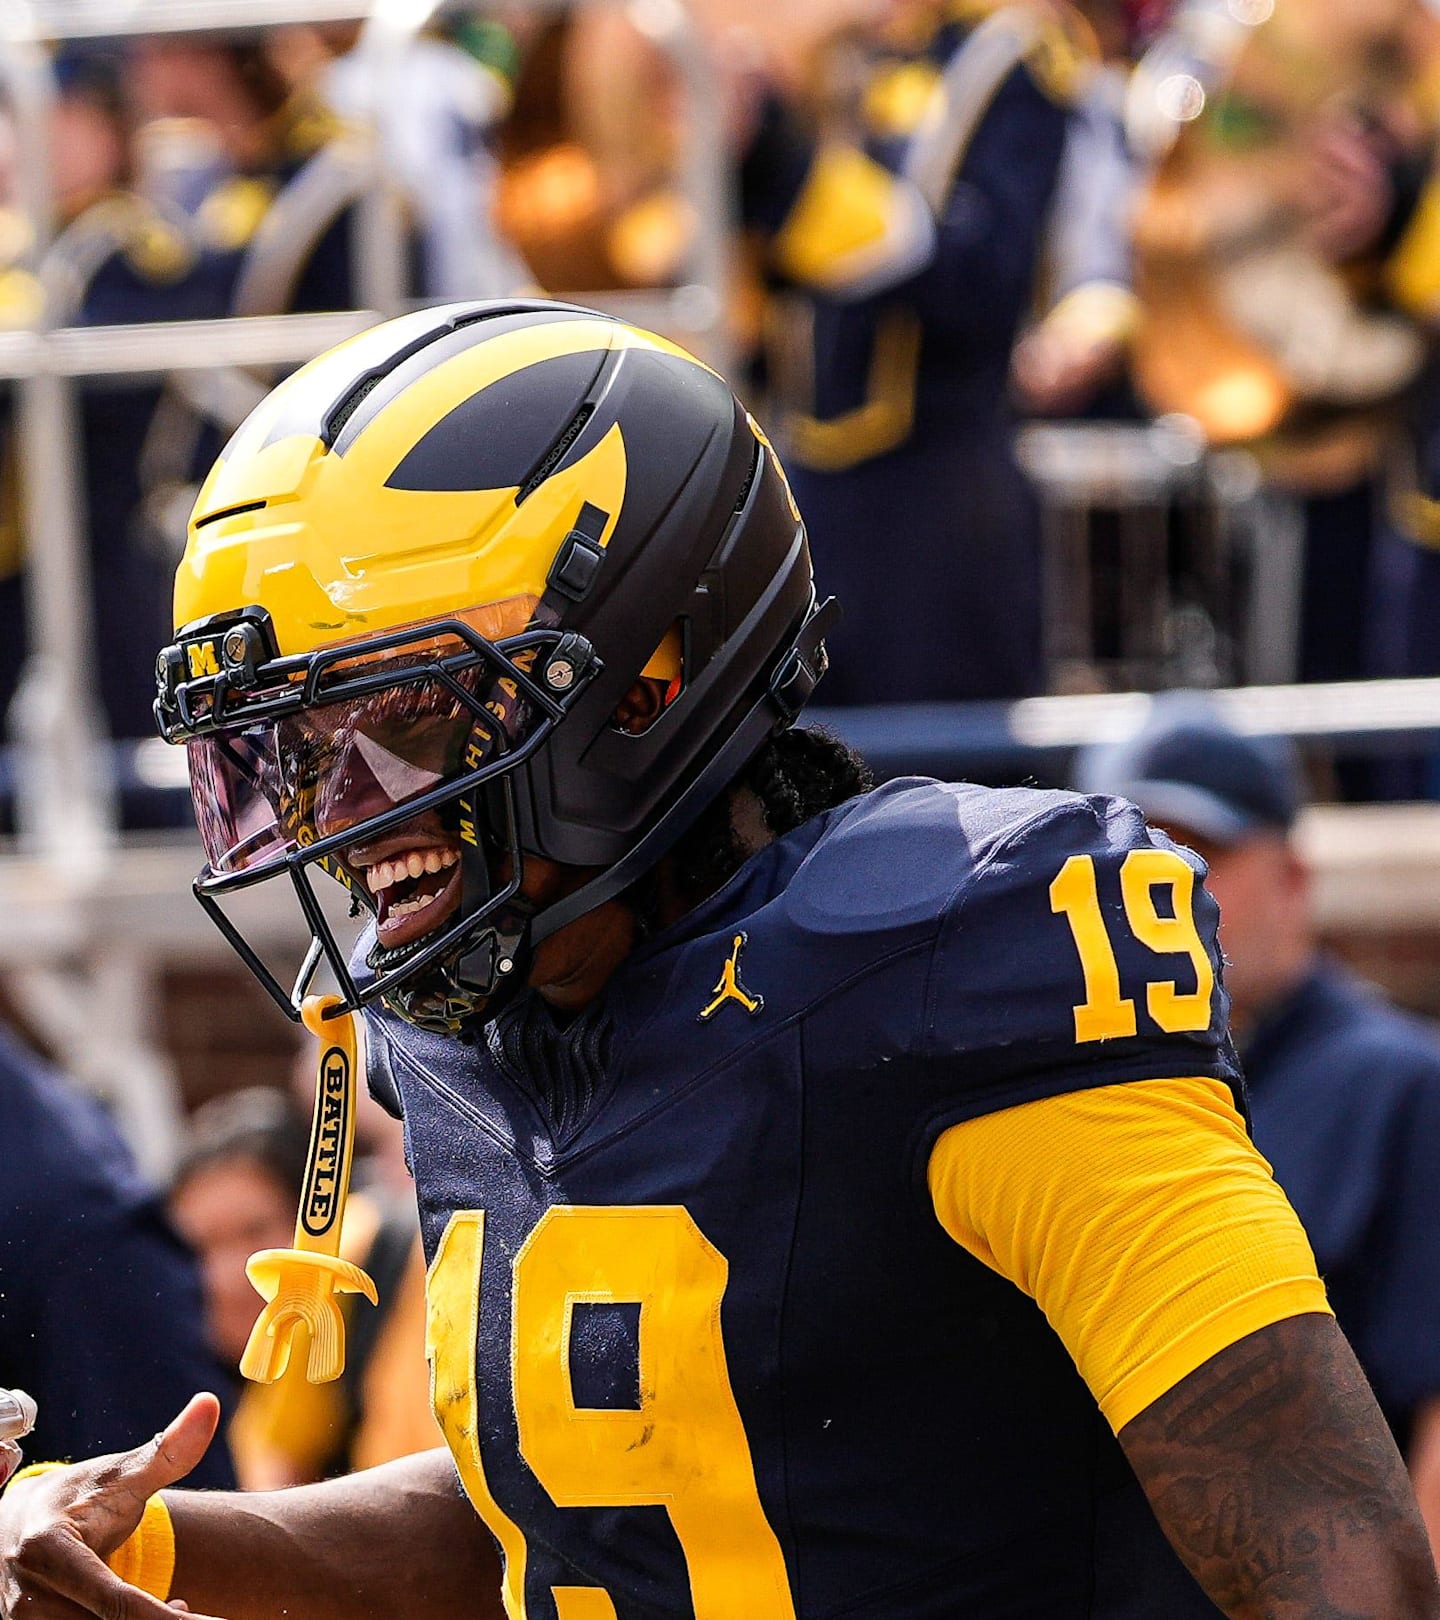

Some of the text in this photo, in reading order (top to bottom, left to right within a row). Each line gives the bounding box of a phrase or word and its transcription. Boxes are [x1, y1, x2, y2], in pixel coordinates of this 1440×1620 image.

[186, 640, 220, 679] M
[1048, 848, 1215, 1044] 19
[309, 1065, 344, 1218] BATTLE
[426, 1204, 797, 1620] 19
